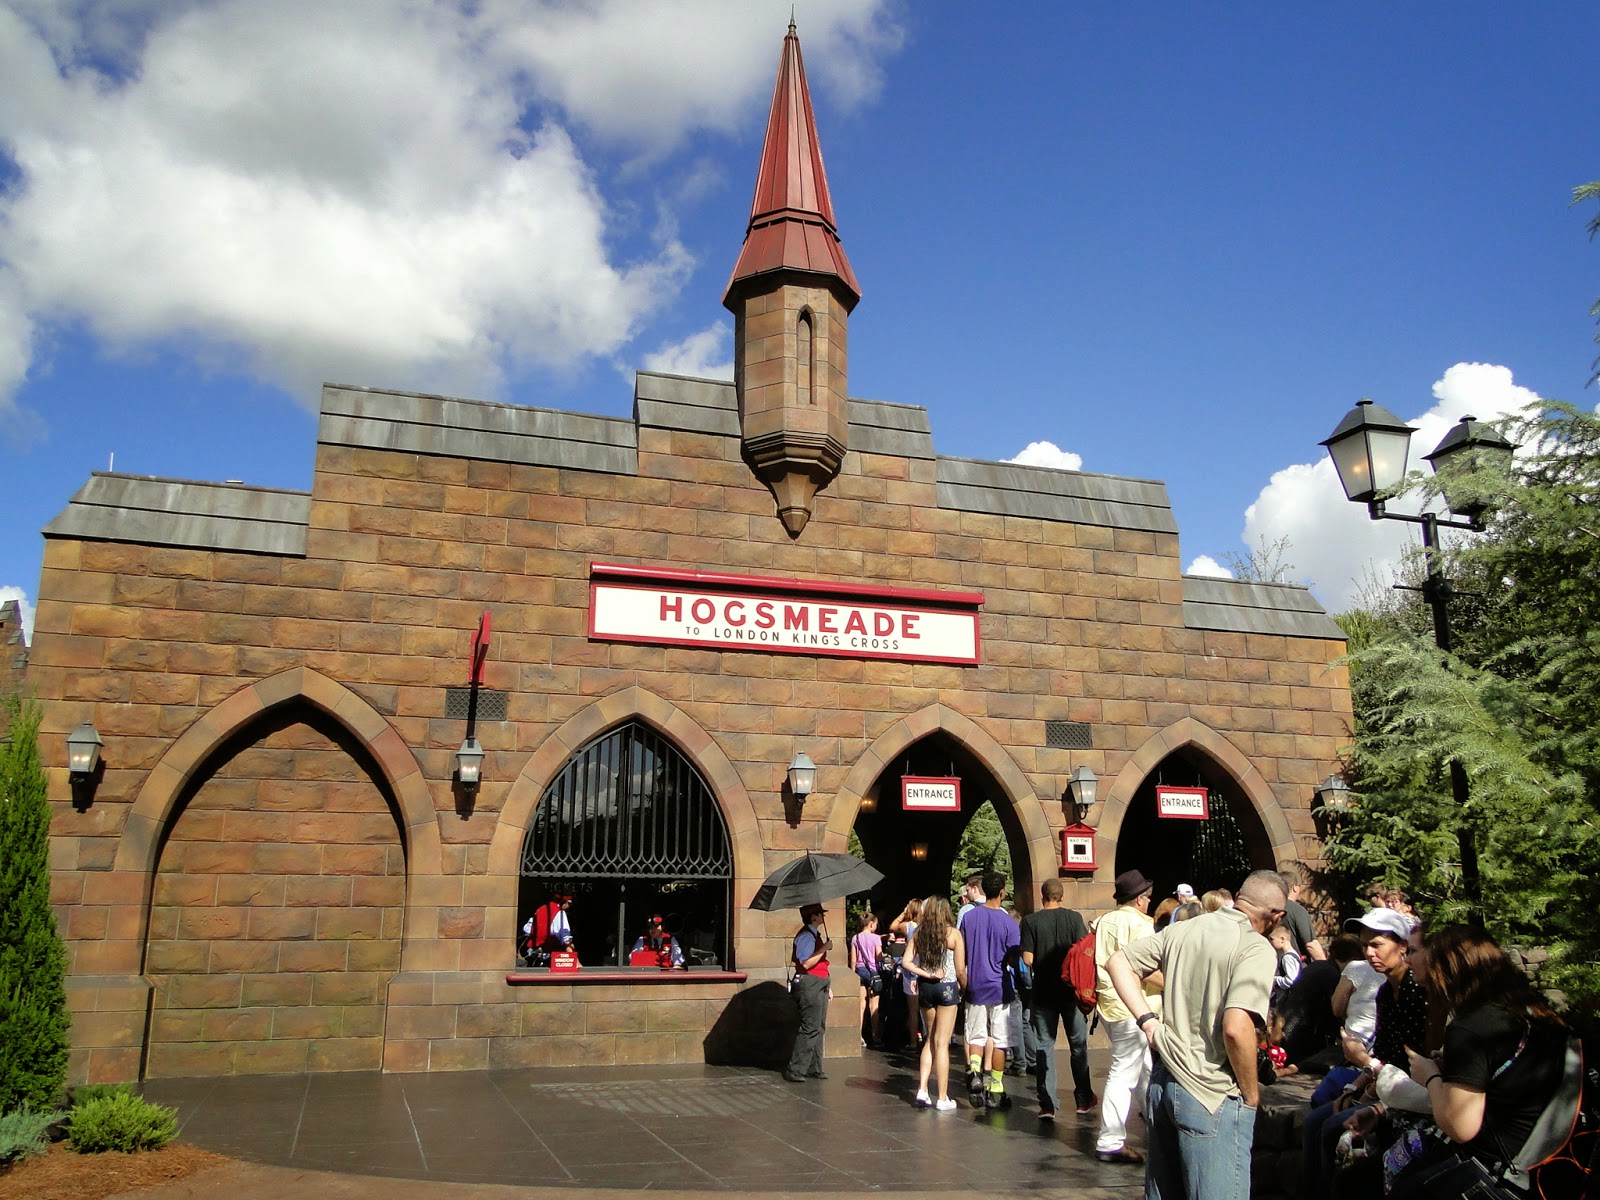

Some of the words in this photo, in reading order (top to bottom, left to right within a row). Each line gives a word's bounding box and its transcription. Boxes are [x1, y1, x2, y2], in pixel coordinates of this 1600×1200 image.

[660, 595, 920, 639] HOGSMEADE
[686, 626, 700, 636] TO
[714, 627, 779, 642] LONDON
[793, 633, 840, 646] KING'S
[851, 637, 899, 650] CROSS
[907, 788, 954, 799] ENTRANCE
[1161, 797, 1201, 808] ENTRANCE
[542, 882, 593, 892] TICKETS
